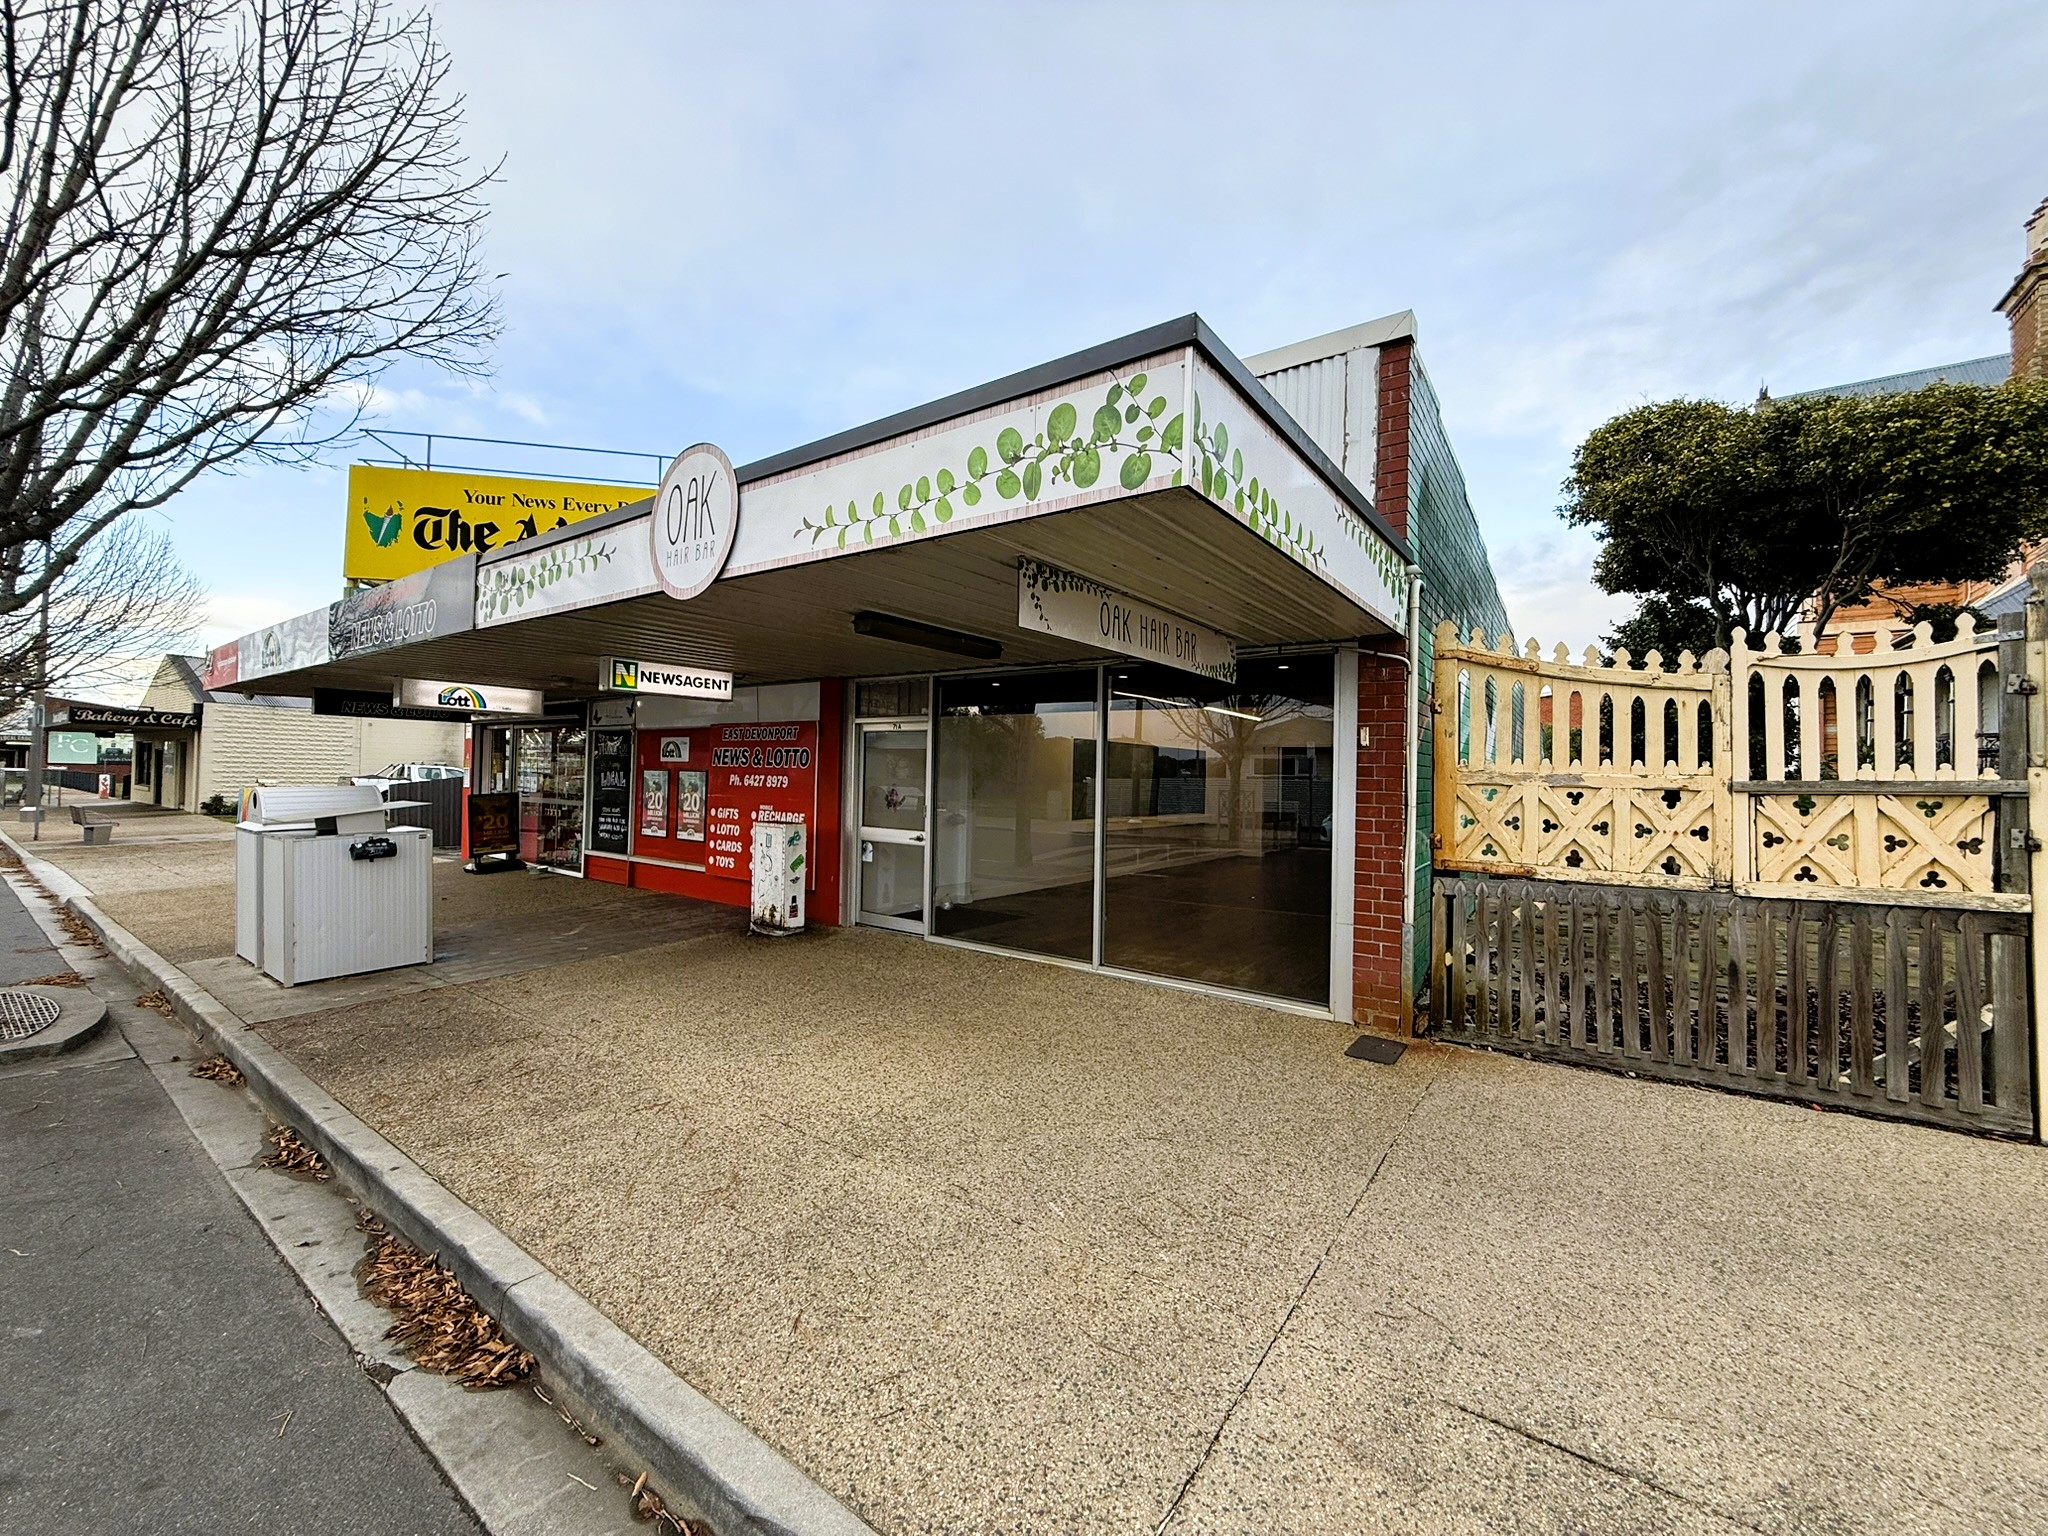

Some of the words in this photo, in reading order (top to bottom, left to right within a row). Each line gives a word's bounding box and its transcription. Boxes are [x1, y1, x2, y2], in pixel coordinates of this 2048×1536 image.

[463, 489, 506, 506] Your
[512, 493, 556, 510] News
[563, 497, 612, 513] Every
[667, 470, 717, 546] OAK
[413, 506, 500, 553] The
[666, 546, 689, 567] HAIR
[695, 540, 715, 561] BAR
[350, 615, 383, 650] NEWS
[383, 611, 394, 642] &
[395, 599, 436, 640] LOTTO
[1100, 602, 1131, 644] OAK
[1140, 614, 1169, 655] HAIR
[1176, 627, 1197, 662] BAR
[640, 670, 730, 691] NEWSAGENT
[341, 701, 388, 715] NEWS
[391, 707, 403, 716] &
[75, 709, 140, 726] Bakery
[143, 713, 158, 724] &
[161, 714, 198, 728] Cafe
[722, 727, 744, 741] EAST
[744, 726, 799, 741] DEVONPORT
[712, 747, 750, 768] NEWS
[751, 746, 763, 768] &
[765, 747, 811, 769] LOTTO
[729, 774, 742, 786] Ph.
[743, 774, 765, 787] 6427
[766, 775, 789, 788] 8979
[646, 792, 663, 809] $20
[681, 793, 700, 812] $20
[717, 807, 739, 819] GIFTS
[758, 810, 805, 823] RECHARGE
[716, 823, 740, 836] LOTTO
[715, 839, 742, 853] CARDS
[715, 855, 735, 869] TOYS
